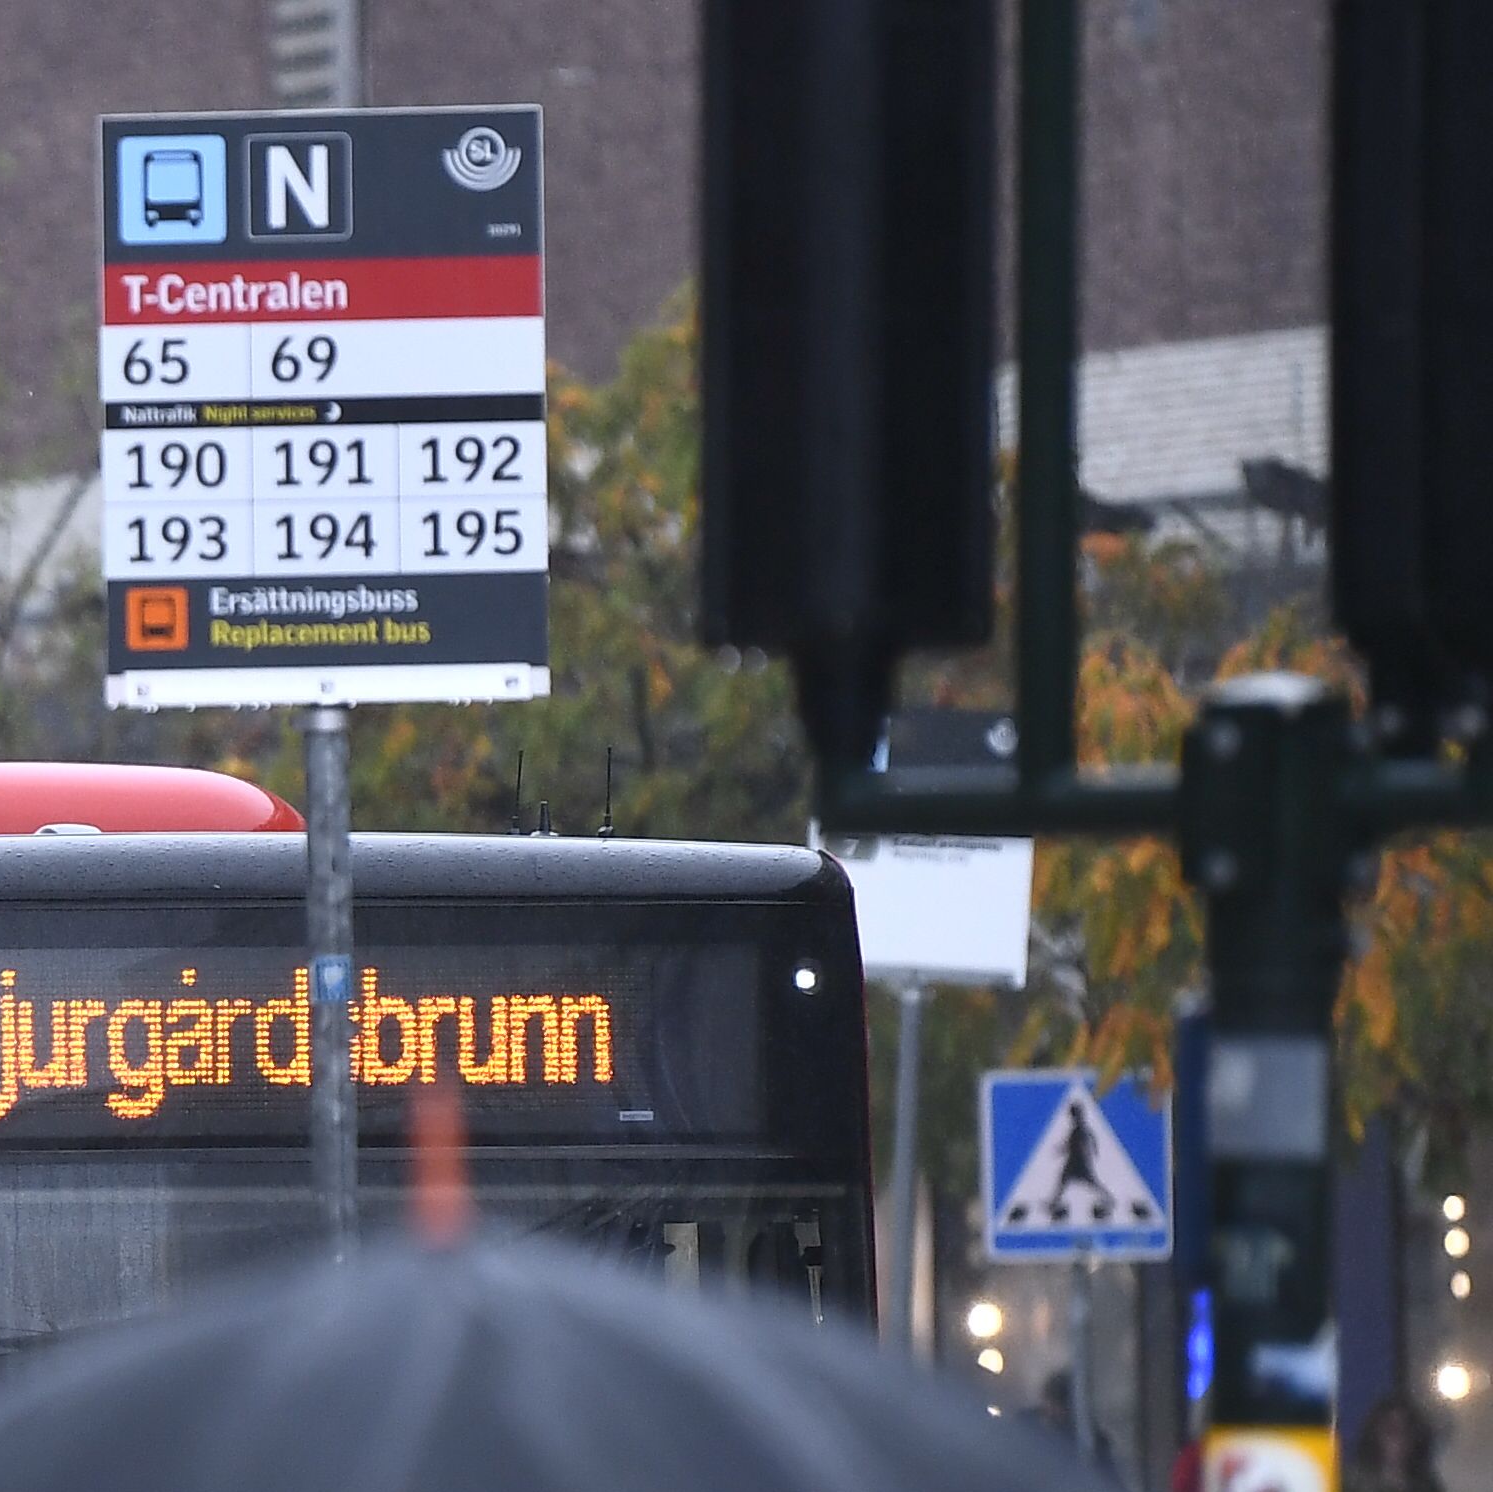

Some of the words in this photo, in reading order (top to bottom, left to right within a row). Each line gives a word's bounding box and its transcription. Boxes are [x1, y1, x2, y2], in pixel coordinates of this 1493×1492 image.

[266, 144, 329, 229] N
[120, 271, 349, 315] T-Centralen
[123, 337, 190, 386] 65
[271, 334, 338, 383] 69
[121, 404, 198, 424] Nattrafik
[202, 403, 249, 426] Night
[251, 406, 318, 422] services
[125, 441, 228, 490] 190
[274, 437, 374, 487] 191
[420, 434, 523, 484] 192
[127, 515, 229, 564] 193
[275, 511, 377, 560] 194
[421, 508, 525, 558] 195
[209, 583, 420, 620] Ersättningsbuss
[210, 618, 380, 652] Replacement
[382, 616, 432, 645] bus
